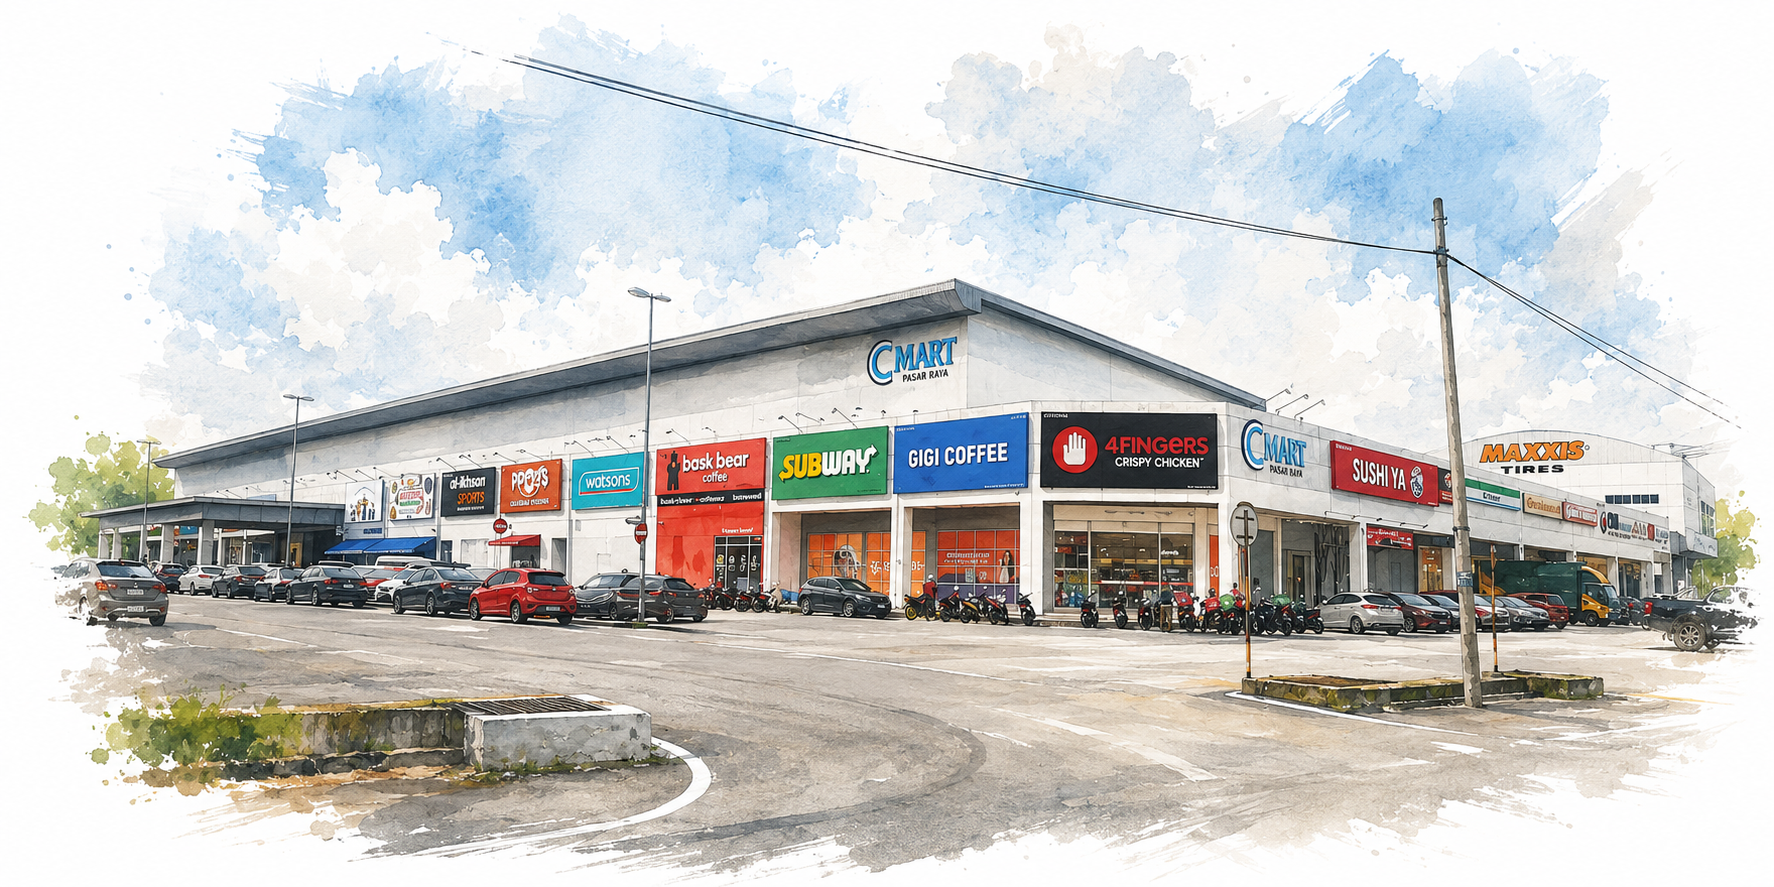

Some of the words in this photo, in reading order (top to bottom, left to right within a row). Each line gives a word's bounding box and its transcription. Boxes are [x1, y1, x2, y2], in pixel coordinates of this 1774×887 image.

[903, 371, 926, 383] PASAR
[929, 369, 949, 379] RAYA
[682, 453, 714, 473] bask
[716, 450, 750, 469] bear
[779, 444, 878, 482] SUBWAY
[908, 447, 940, 469] GIGI
[944, 442, 1009, 466] COFFEE
[1115, 456, 1152, 468] CRISPY
[1154, 457, 1200, 468] CHICKEN
[1352, 458, 1389, 488] SUSHI
[1390, 466, 1407, 491] YA
[1500, 464, 1565, 475] TIRES
[457, 491, 485, 505] SPORTS
